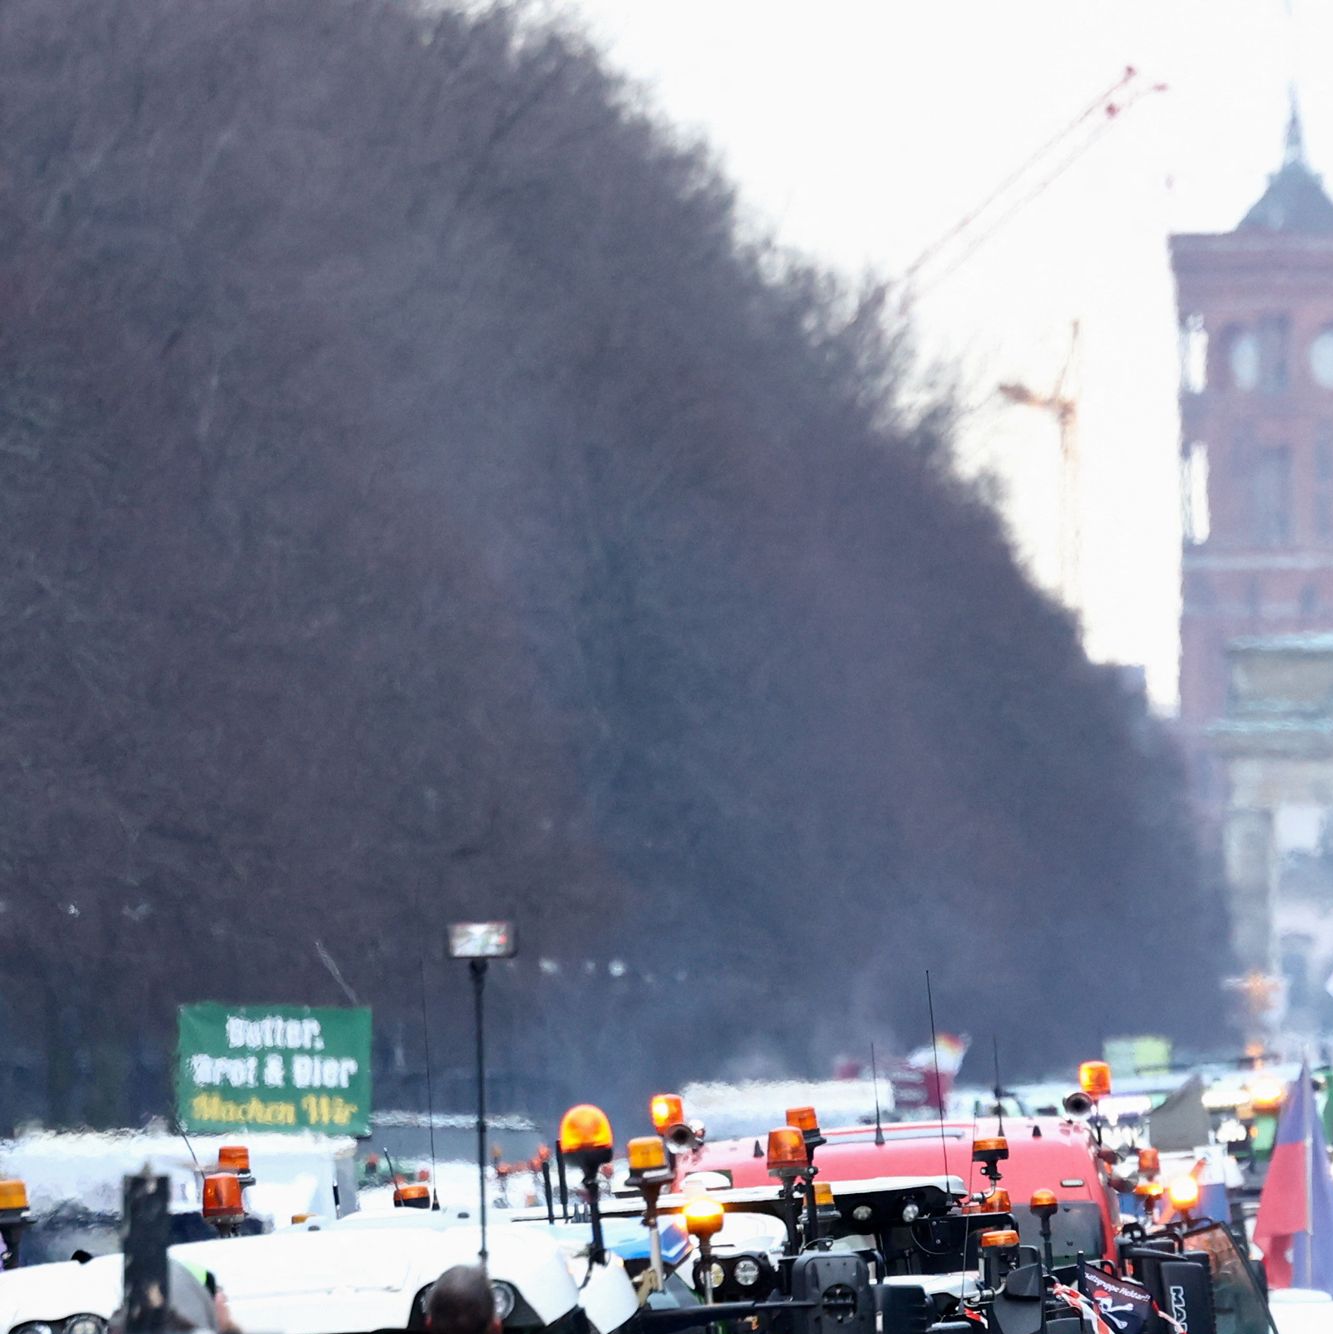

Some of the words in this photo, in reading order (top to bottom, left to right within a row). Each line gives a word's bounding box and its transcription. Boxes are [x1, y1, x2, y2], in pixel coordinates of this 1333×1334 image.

[189, 1053, 258, 1088] Brot
[264, 1053, 284, 1087] &
[292, 1053, 358, 1088] Bier
